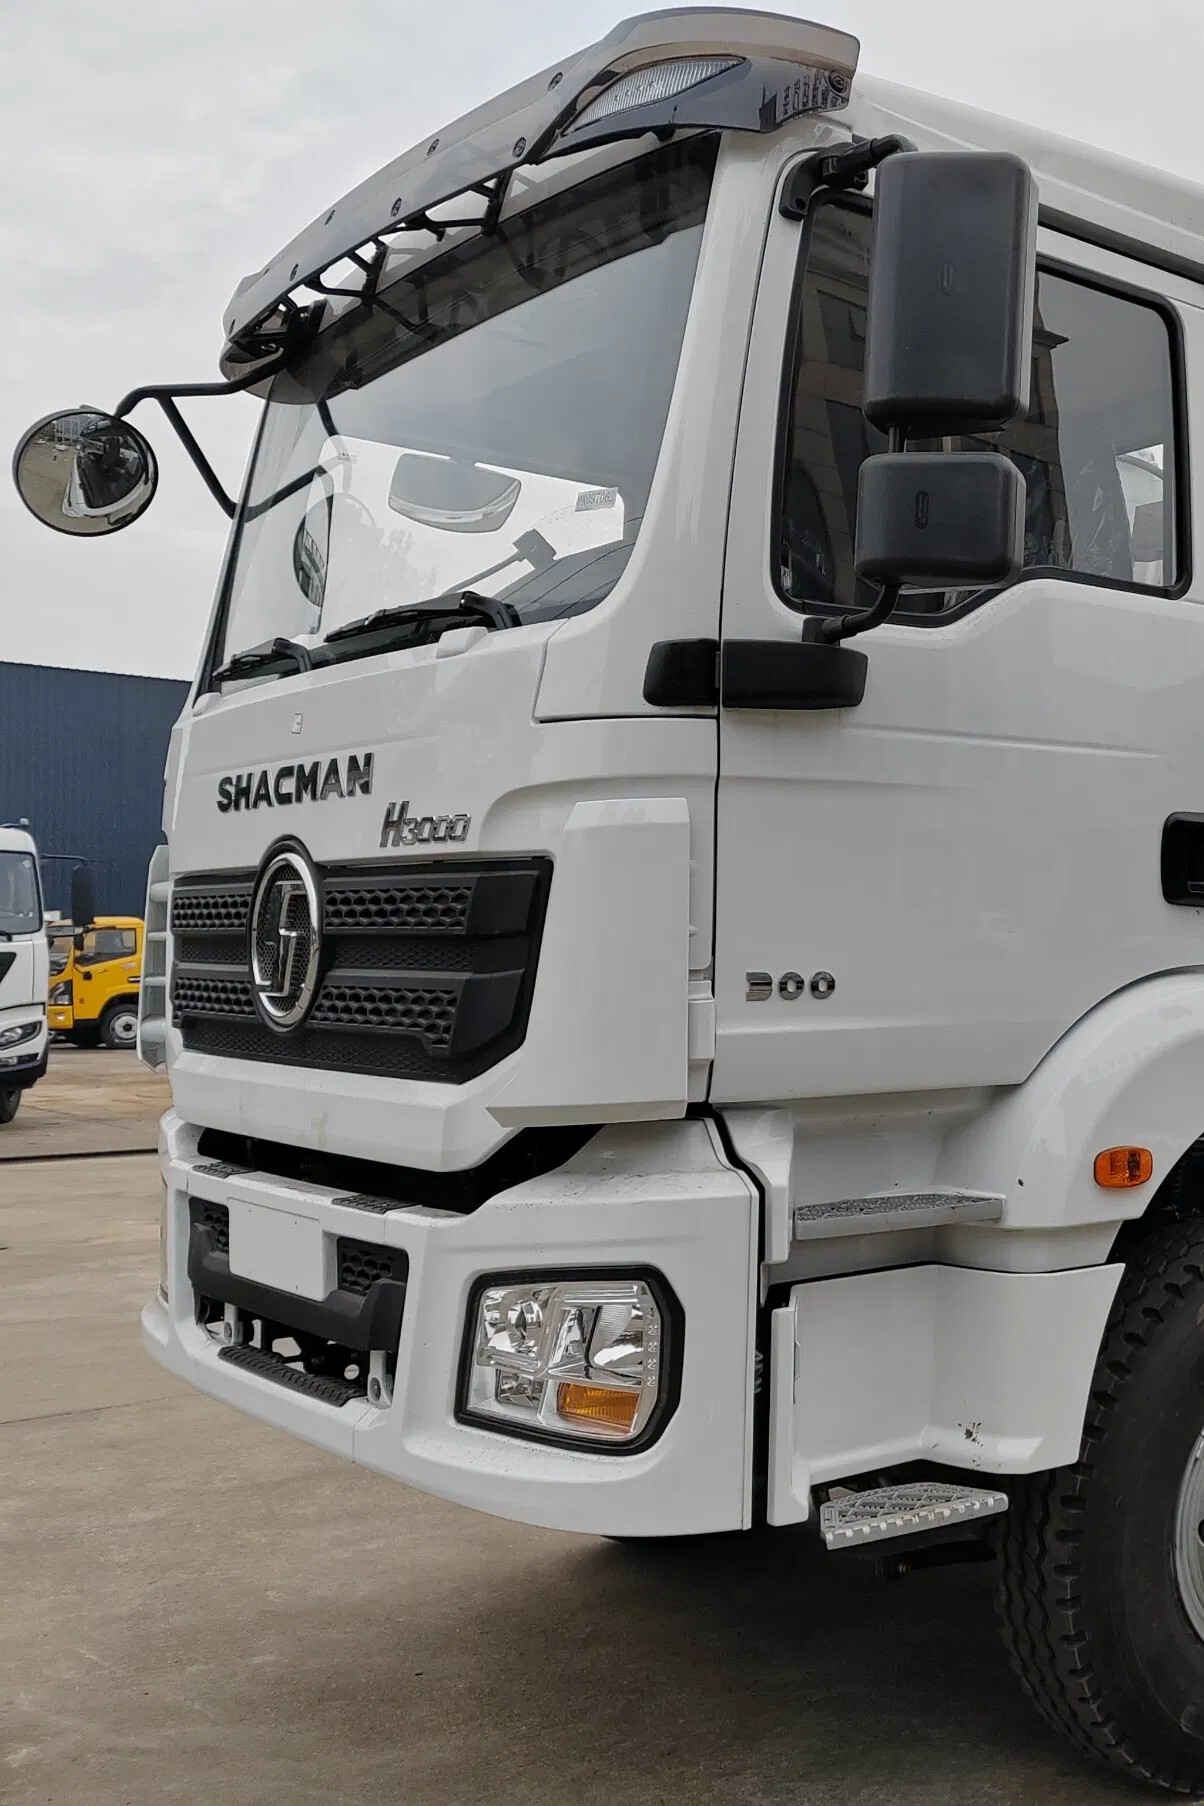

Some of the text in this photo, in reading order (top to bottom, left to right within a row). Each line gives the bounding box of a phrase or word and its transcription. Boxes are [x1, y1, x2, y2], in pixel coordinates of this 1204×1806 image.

[216, 752, 374, 813] SHACMAN
[379, 800, 471, 848] H3000
[746, 970, 835, 1001] 300
